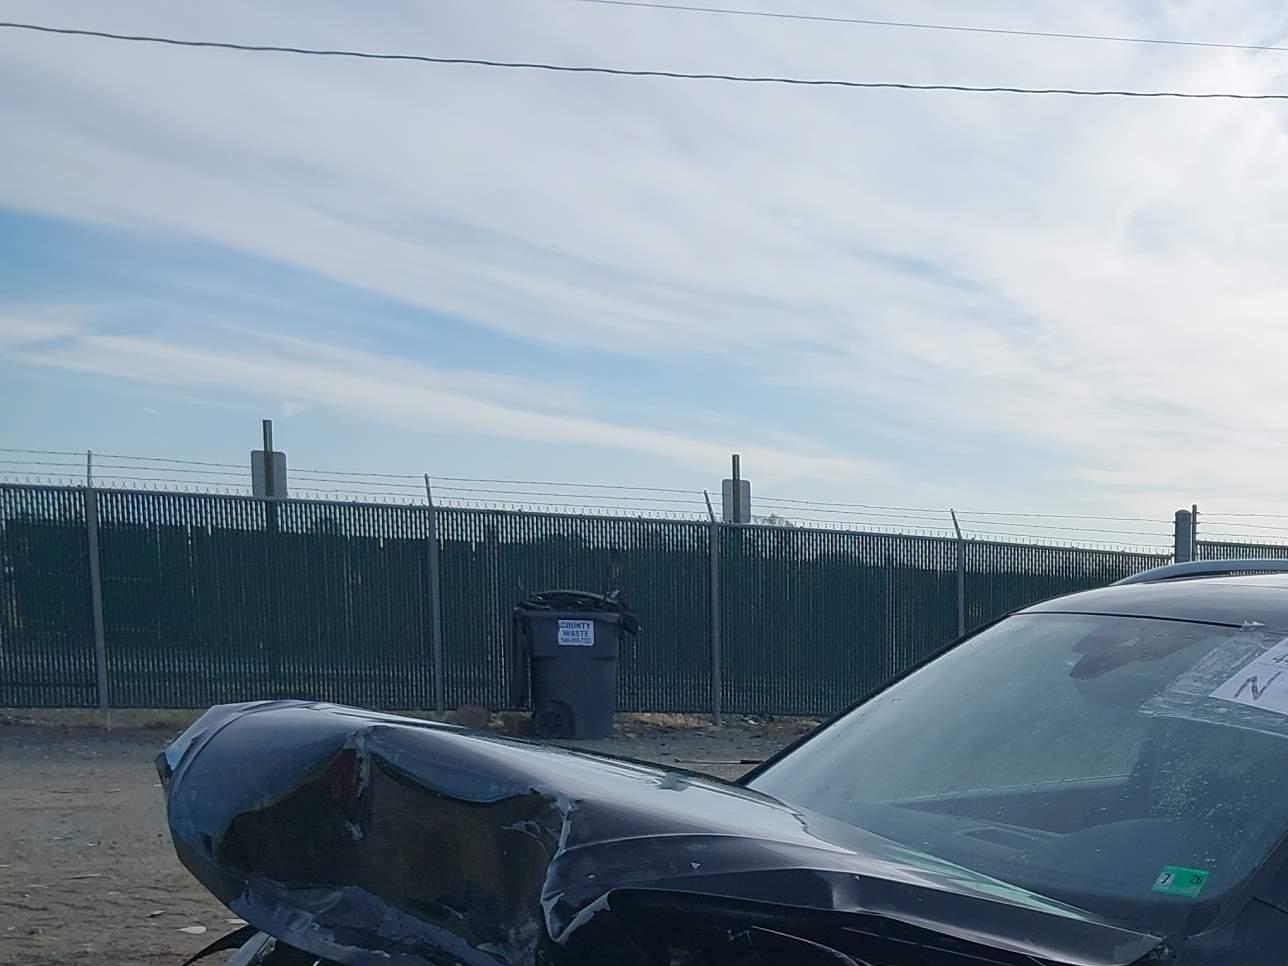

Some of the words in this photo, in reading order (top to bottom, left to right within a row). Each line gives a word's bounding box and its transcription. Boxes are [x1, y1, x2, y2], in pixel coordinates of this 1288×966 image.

[560, 621, 590, 630] COUNTY
[562, 629, 590, 639] WASTE
[1233, 671, 1282, 701] N
